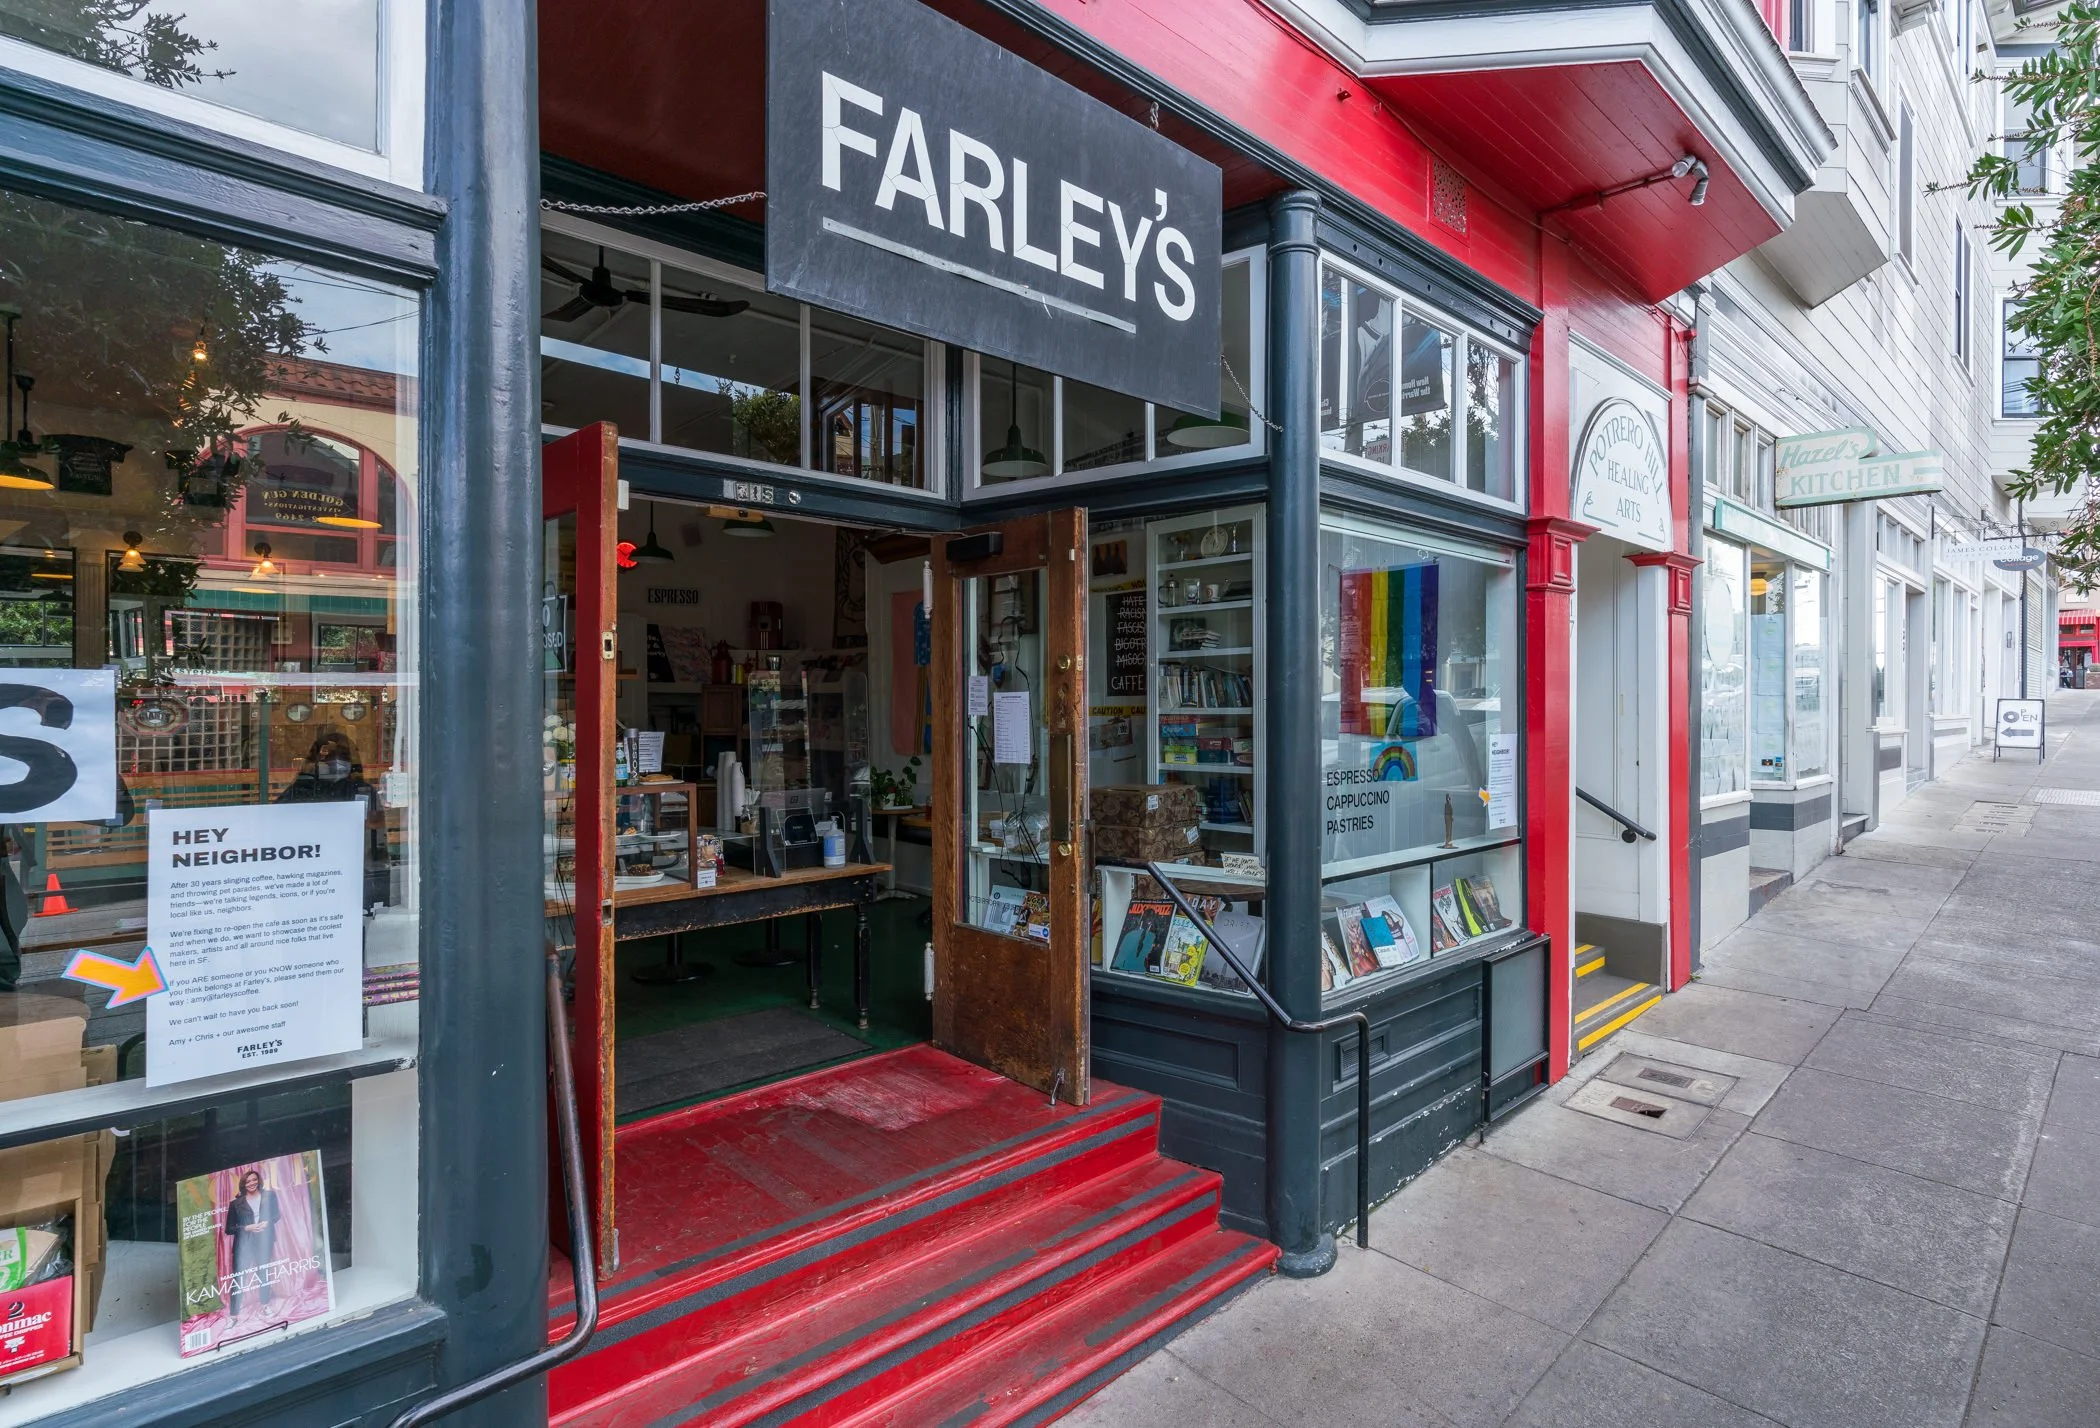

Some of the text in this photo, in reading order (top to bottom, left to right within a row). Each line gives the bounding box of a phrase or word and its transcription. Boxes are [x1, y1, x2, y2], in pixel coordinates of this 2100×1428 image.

[822, 70, 1196, 322] FARLEY'S
[1589, 415, 1664, 504] POTRERO HILL
[1781, 439, 1859, 468] Hazel's
[1608, 458, 1649, 495] HEALING
[1791, 463, 1900, 496] KITCHEN
[1616, 497, 1641, 523] ARTS
[648, 588, 699, 605] ESPRESSO
[1112, 674, 1145, 691] CAFFE
[2003, 709, 2038, 724] OPEN
[1327, 769, 1380, 787] ESPRESSO
[1326, 790, 1390, 811] CAPPUCCINO
[1327, 815, 1374, 835] PASTRIES
[172, 828, 229, 845] HEY
[172, 844, 321, 868] NEIGHBOR!
[191, 880, 200, 888] 30
[224, 876, 250, 885] slinging
[277, 872, 304, 880] hawking
[187, 889, 217, 898] throwing
[225, 896, 248, 904] talking
[316, 888, 336, 896] you're
[170, 910, 188, 918] local
[170, 930, 192, 938] We're
[194, 927, 213, 936] fixing
[170, 940, 184, 948] and
[186, 938, 206, 946] when
[272, 927, 305, 936] showcase
[319, 923, 342, 931] coolest
[201, 946, 223, 954] artists
[250, 940, 274, 948] around
[276, 937, 289, 945] nice
[291, 935, 307, 943] folks
[170, 960, 186, 968] here
[176, 979, 190, 987] you
[192, 976, 209, 984] ARE
[211, 972, 244, 981] someone
[254, 969, 267, 977] you
[269, 965, 292, 974] KNOW
[294, 962, 324, 970] someone
[169, 990, 183, 998] you
[204, 982, 232, 992] belongs
[274, 974, 296, 982] please
[169, 999, 184, 1007] way
[184, 1016, 202, 1024] can't
[203, 1012, 218, 1020] wait
[229, 1008, 246, 1016] have
[248, 1007, 260, 1015] you
[169, 1038, 186, 1047] Amy
[195, 1033, 214, 1042] Chris
[236, 1024, 269, 1034] awesome
[237, 1040, 282, 1054] FARLEY'S
[261, 1048, 278, 1056] 1989
[186, 1256, 321, 1305] KAMALA HARRIS
